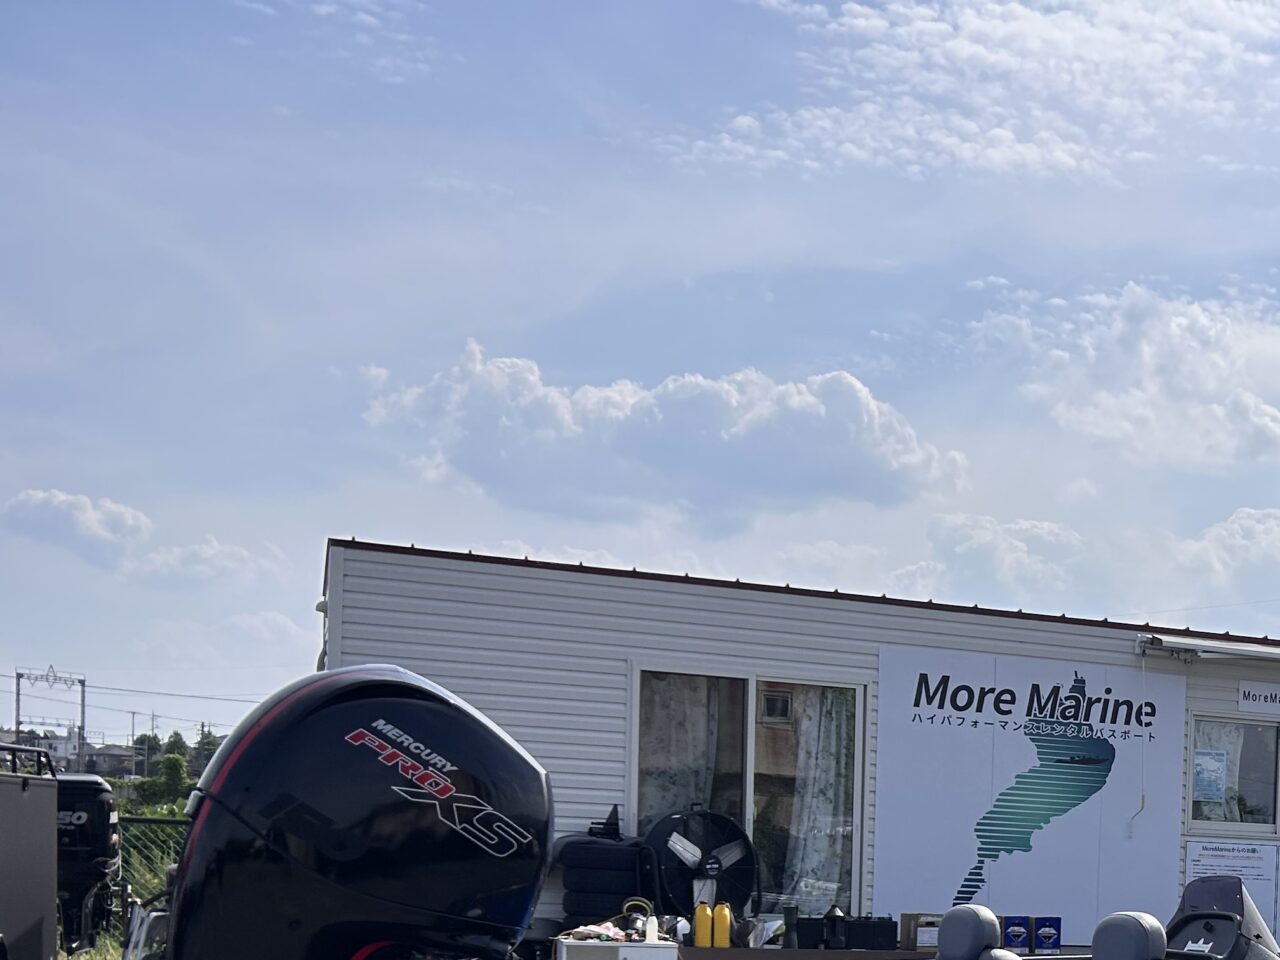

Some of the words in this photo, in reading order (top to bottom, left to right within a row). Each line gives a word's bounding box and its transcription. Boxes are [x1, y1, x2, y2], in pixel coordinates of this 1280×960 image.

[912, 672, 1017, 716] More
[1025, 683, 1157, 728] Marine
[345, 728, 456, 798] PRO
[371, 719, 459, 773] MERCURY
[390, 786, 533, 857] XS
